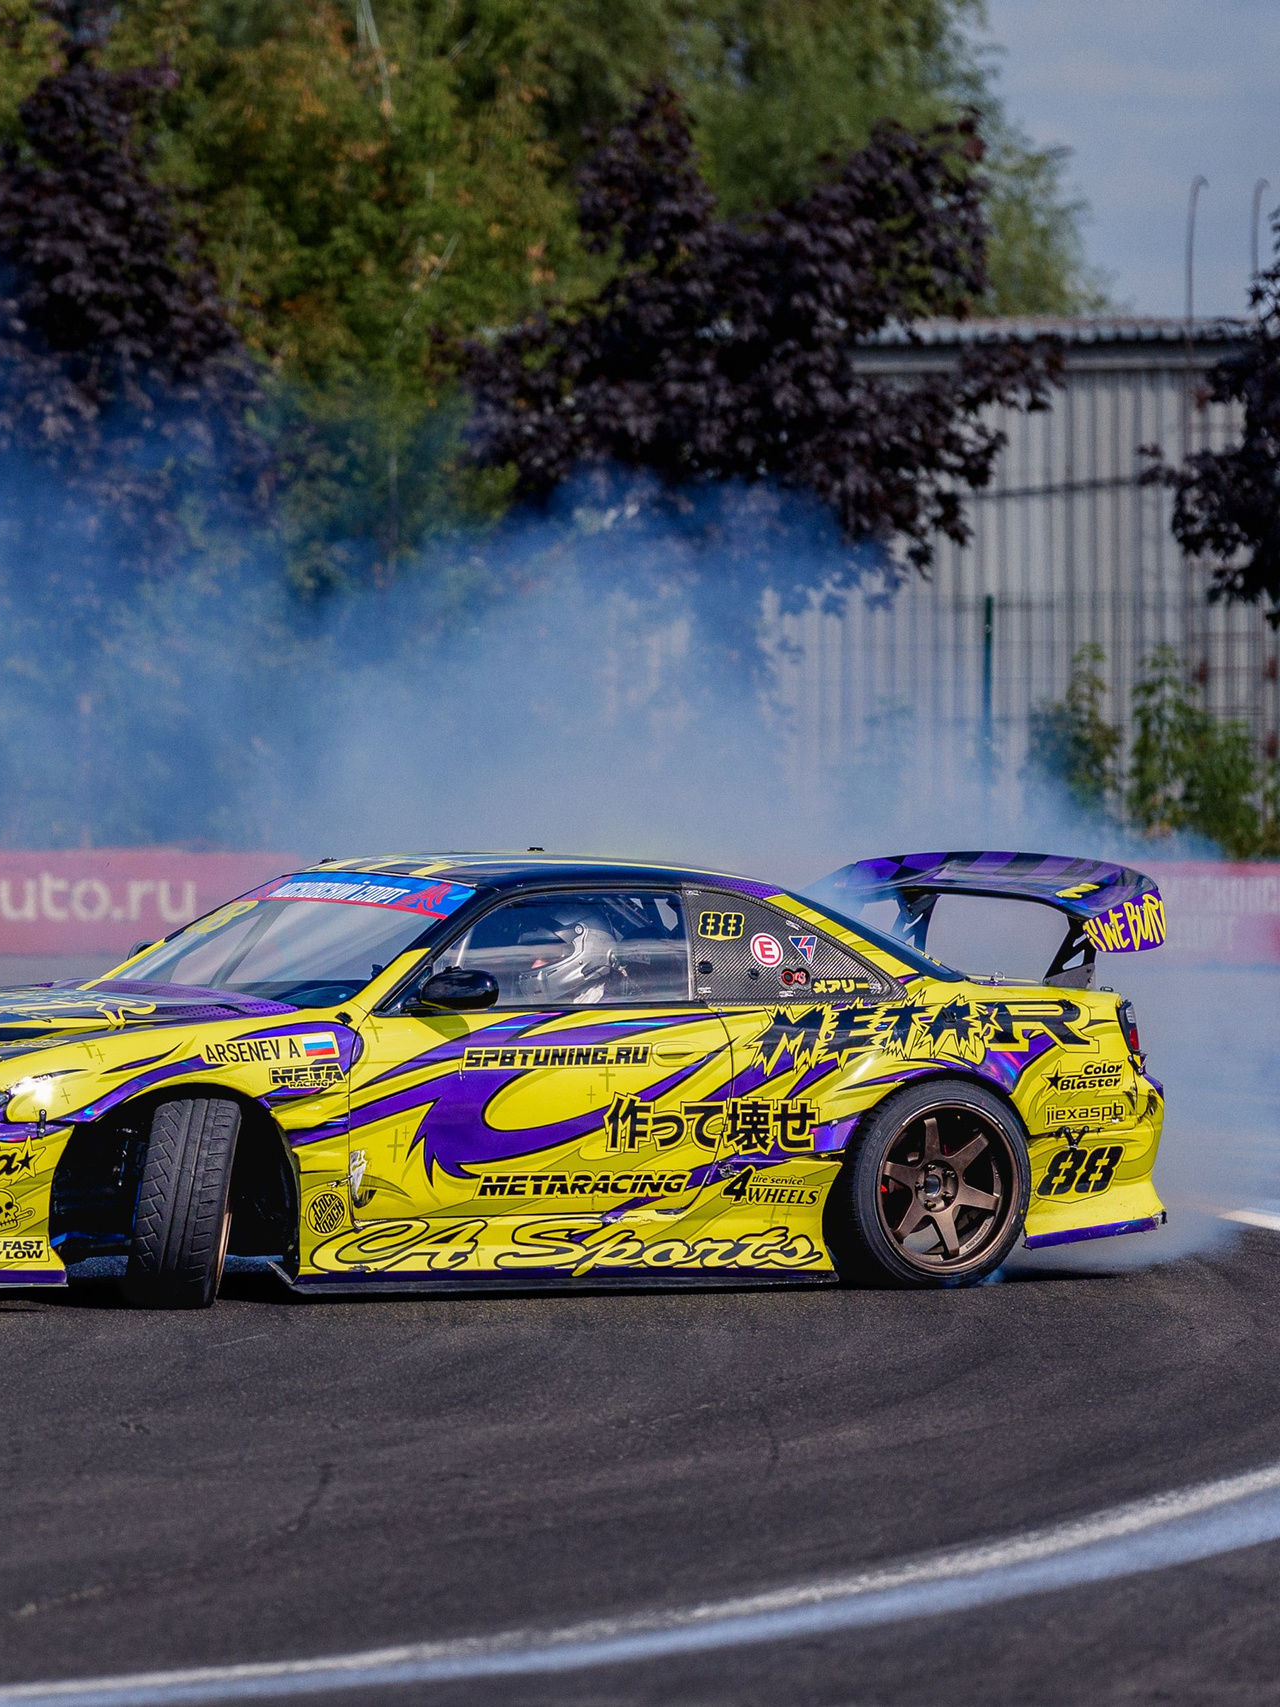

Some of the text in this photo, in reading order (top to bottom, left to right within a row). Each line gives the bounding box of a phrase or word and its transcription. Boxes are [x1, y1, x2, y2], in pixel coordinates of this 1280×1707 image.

[699, 912, 744, 938] 88
[759, 941, 775, 959] E
[205, 1038, 301, 1062] ARSENEV A
[271, 1066, 344, 1083] META
[1084, 1063, 1122, 1075] Color
[1060, 1078, 1120, 1091] Blaster
[607, 1097, 817, 1153] 作って壊せ
[1046, 1102, 1124, 1125] jiexaspb
[752, 1175, 803, 1185] tire service
[1037, 1145, 1124, 1196] 88
[477, 1173, 688, 1197] METARACING
[723, 1168, 819, 1204] 4 WHEELS
[2, 1241, 43, 1250] FAST
[6, 1250, 43, 1259] LOW
[494, 1216, 824, 1277] Sports
